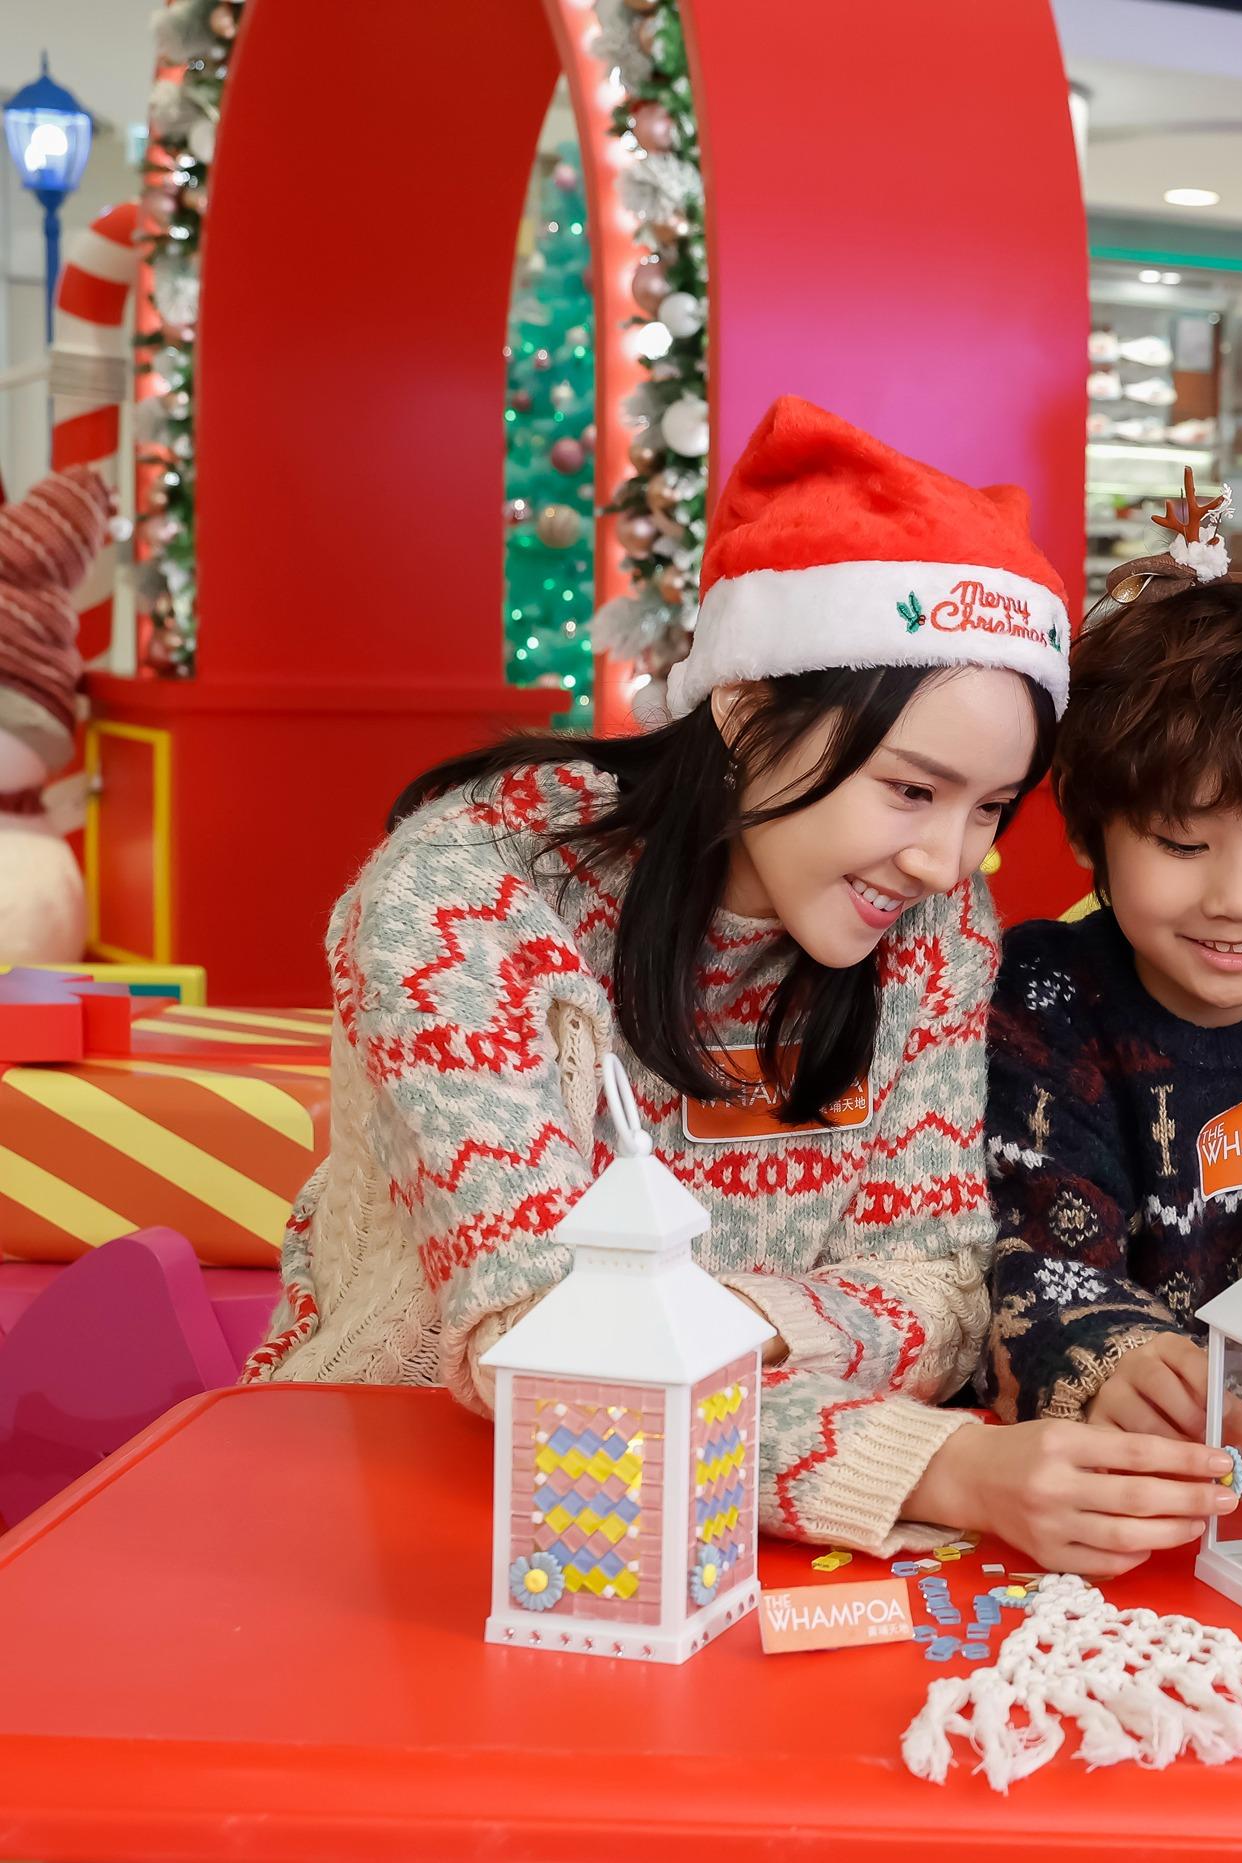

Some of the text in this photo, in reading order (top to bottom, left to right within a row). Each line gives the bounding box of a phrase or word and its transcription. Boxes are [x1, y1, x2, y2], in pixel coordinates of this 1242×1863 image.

[949, 580, 1031, 626] Merry
[930, 601, 1048, 648] Christmas
[818, 1095, 867, 1114] 埔天地
[1201, 1121, 1225, 1145] THE
[763, 1593, 792, 1610] THE
[767, 1597, 906, 1633] WHAMPOA
